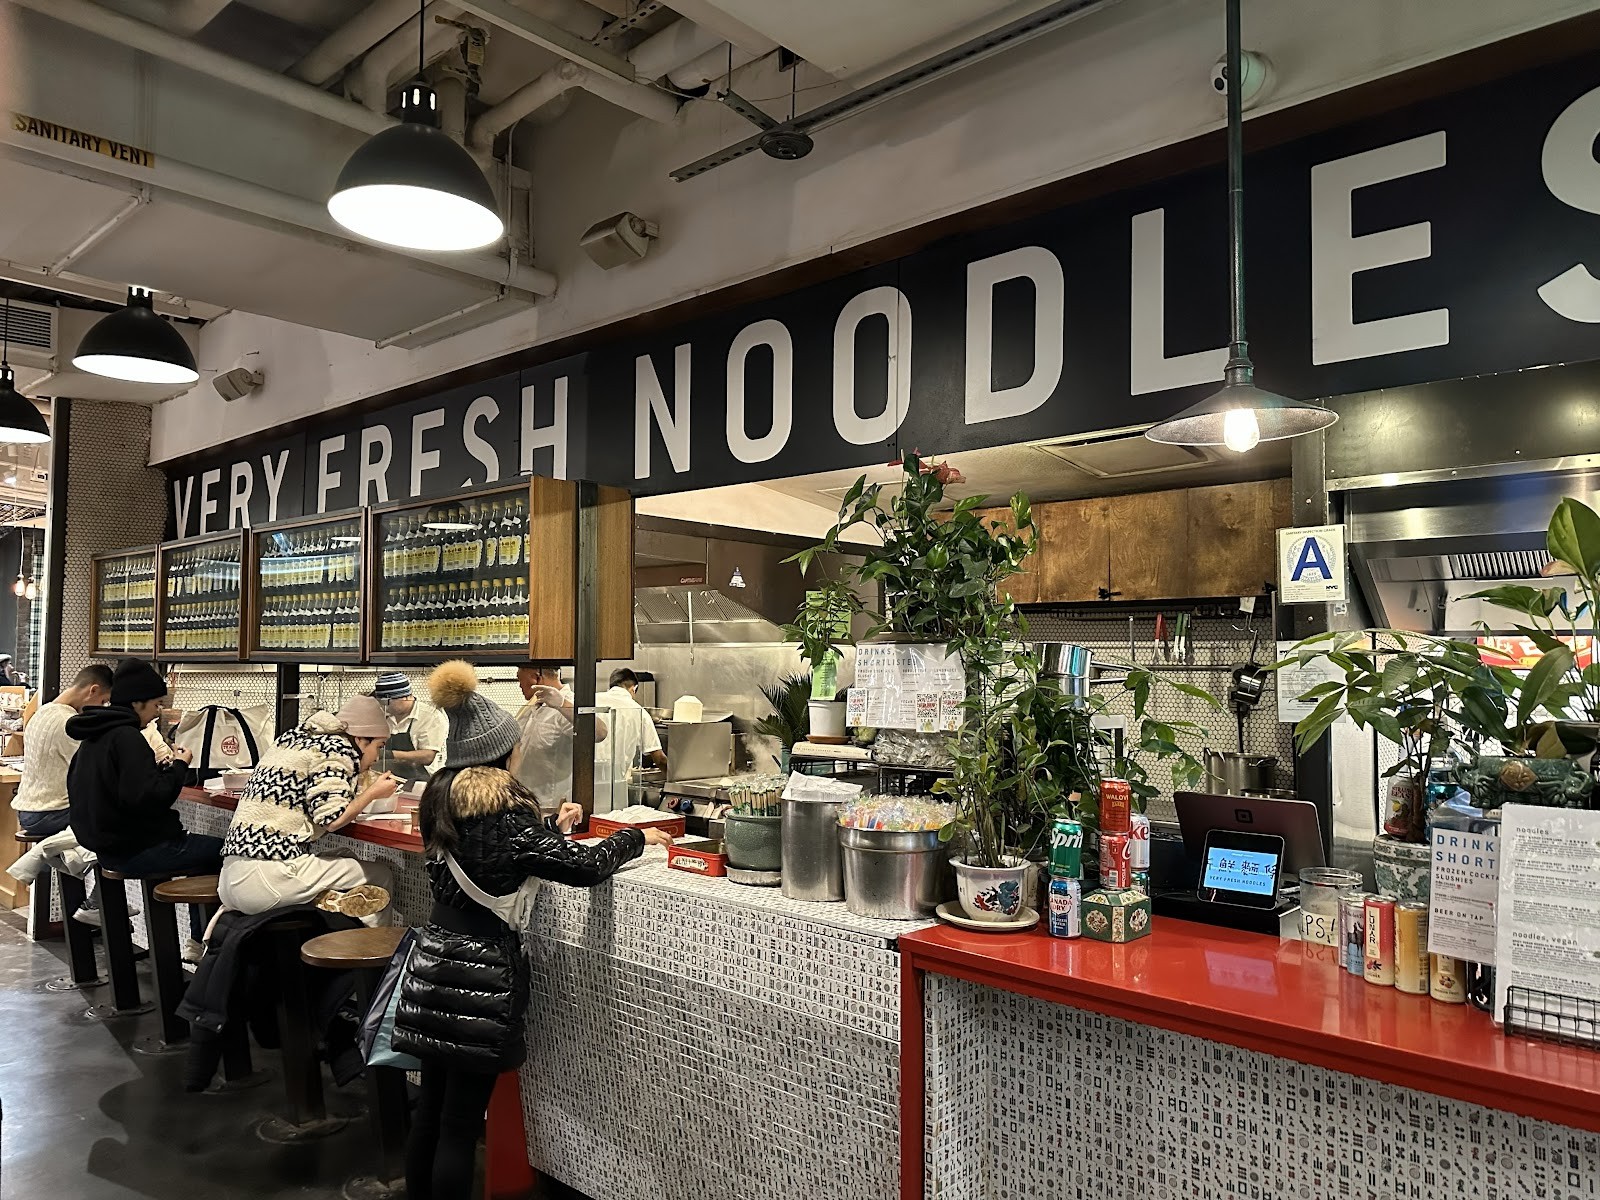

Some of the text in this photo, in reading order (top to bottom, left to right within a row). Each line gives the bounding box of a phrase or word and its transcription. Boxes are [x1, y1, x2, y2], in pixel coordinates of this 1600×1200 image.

[15, 112, 149, 167] SANITARY VENT
[173, 449, 290, 540] VERY
[317, 375, 568, 514] FRESH
[1290, 537, 1333, 581] A
[858, 647, 895, 657] DRINKS,
[1516, 827, 1549, 835] noodles
[1436, 834, 1495, 853] DRINK
[1435, 851, 1495, 869] SHORT
[1435, 873, 1474, 885] SLUSHIES
[1436, 866, 1466, 876] FROZEN
[1434, 907, 1454, 916] BEER
[1470, 913, 1484, 921] TAP
[1368, 910, 1377, 944] LUNAR
[1512, 931, 1578, 946] noodles, vegan
